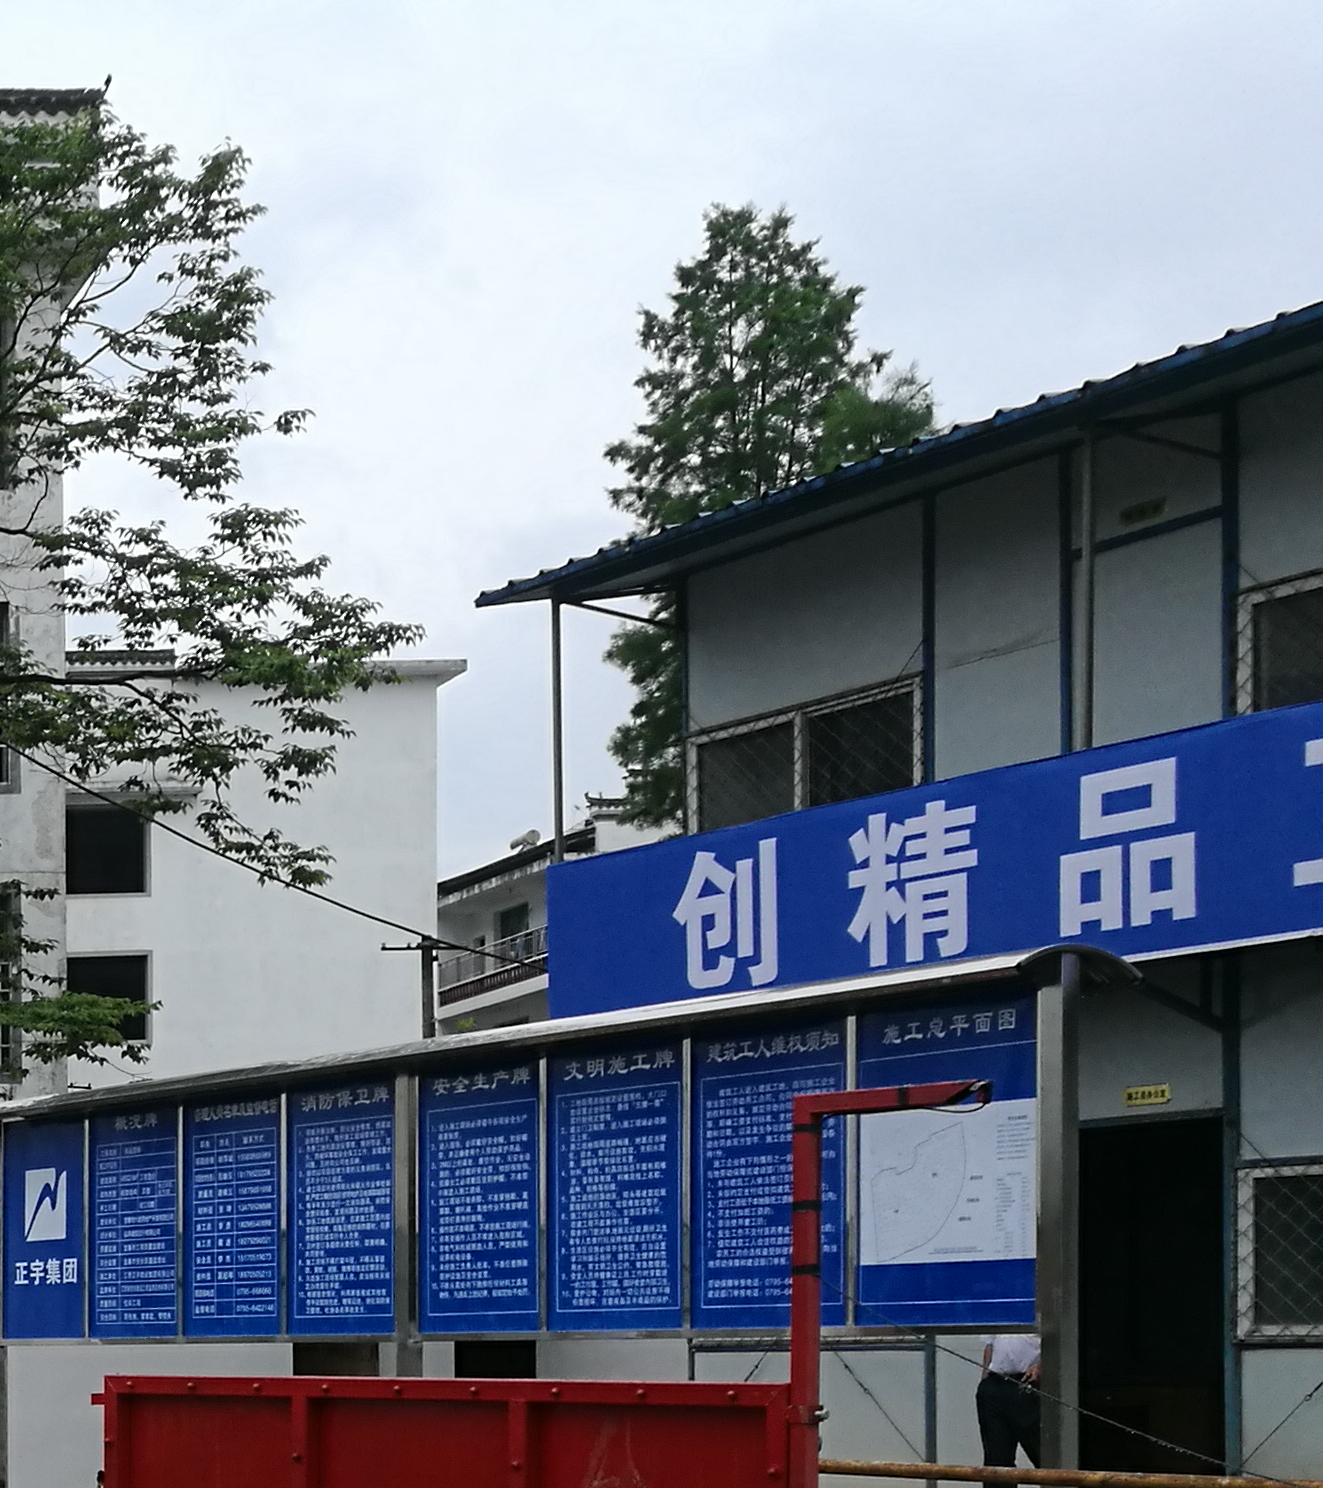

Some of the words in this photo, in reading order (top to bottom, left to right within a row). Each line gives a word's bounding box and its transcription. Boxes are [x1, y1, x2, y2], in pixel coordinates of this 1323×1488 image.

[672, 737, 1323, 990] 创精品
[882, 1008, 1016, 1045] 施工总平面图
[706, 1031, 839, 1063] 建筑工人维权须知
[433, 1066, 531, 1096] 安全生产牌
[564, 1049, 675, 1081] 文明施工牌
[301, 1086, 390, 1112] 消防保卫牌
[14, 1257, 78, 1285] 正宇集团
